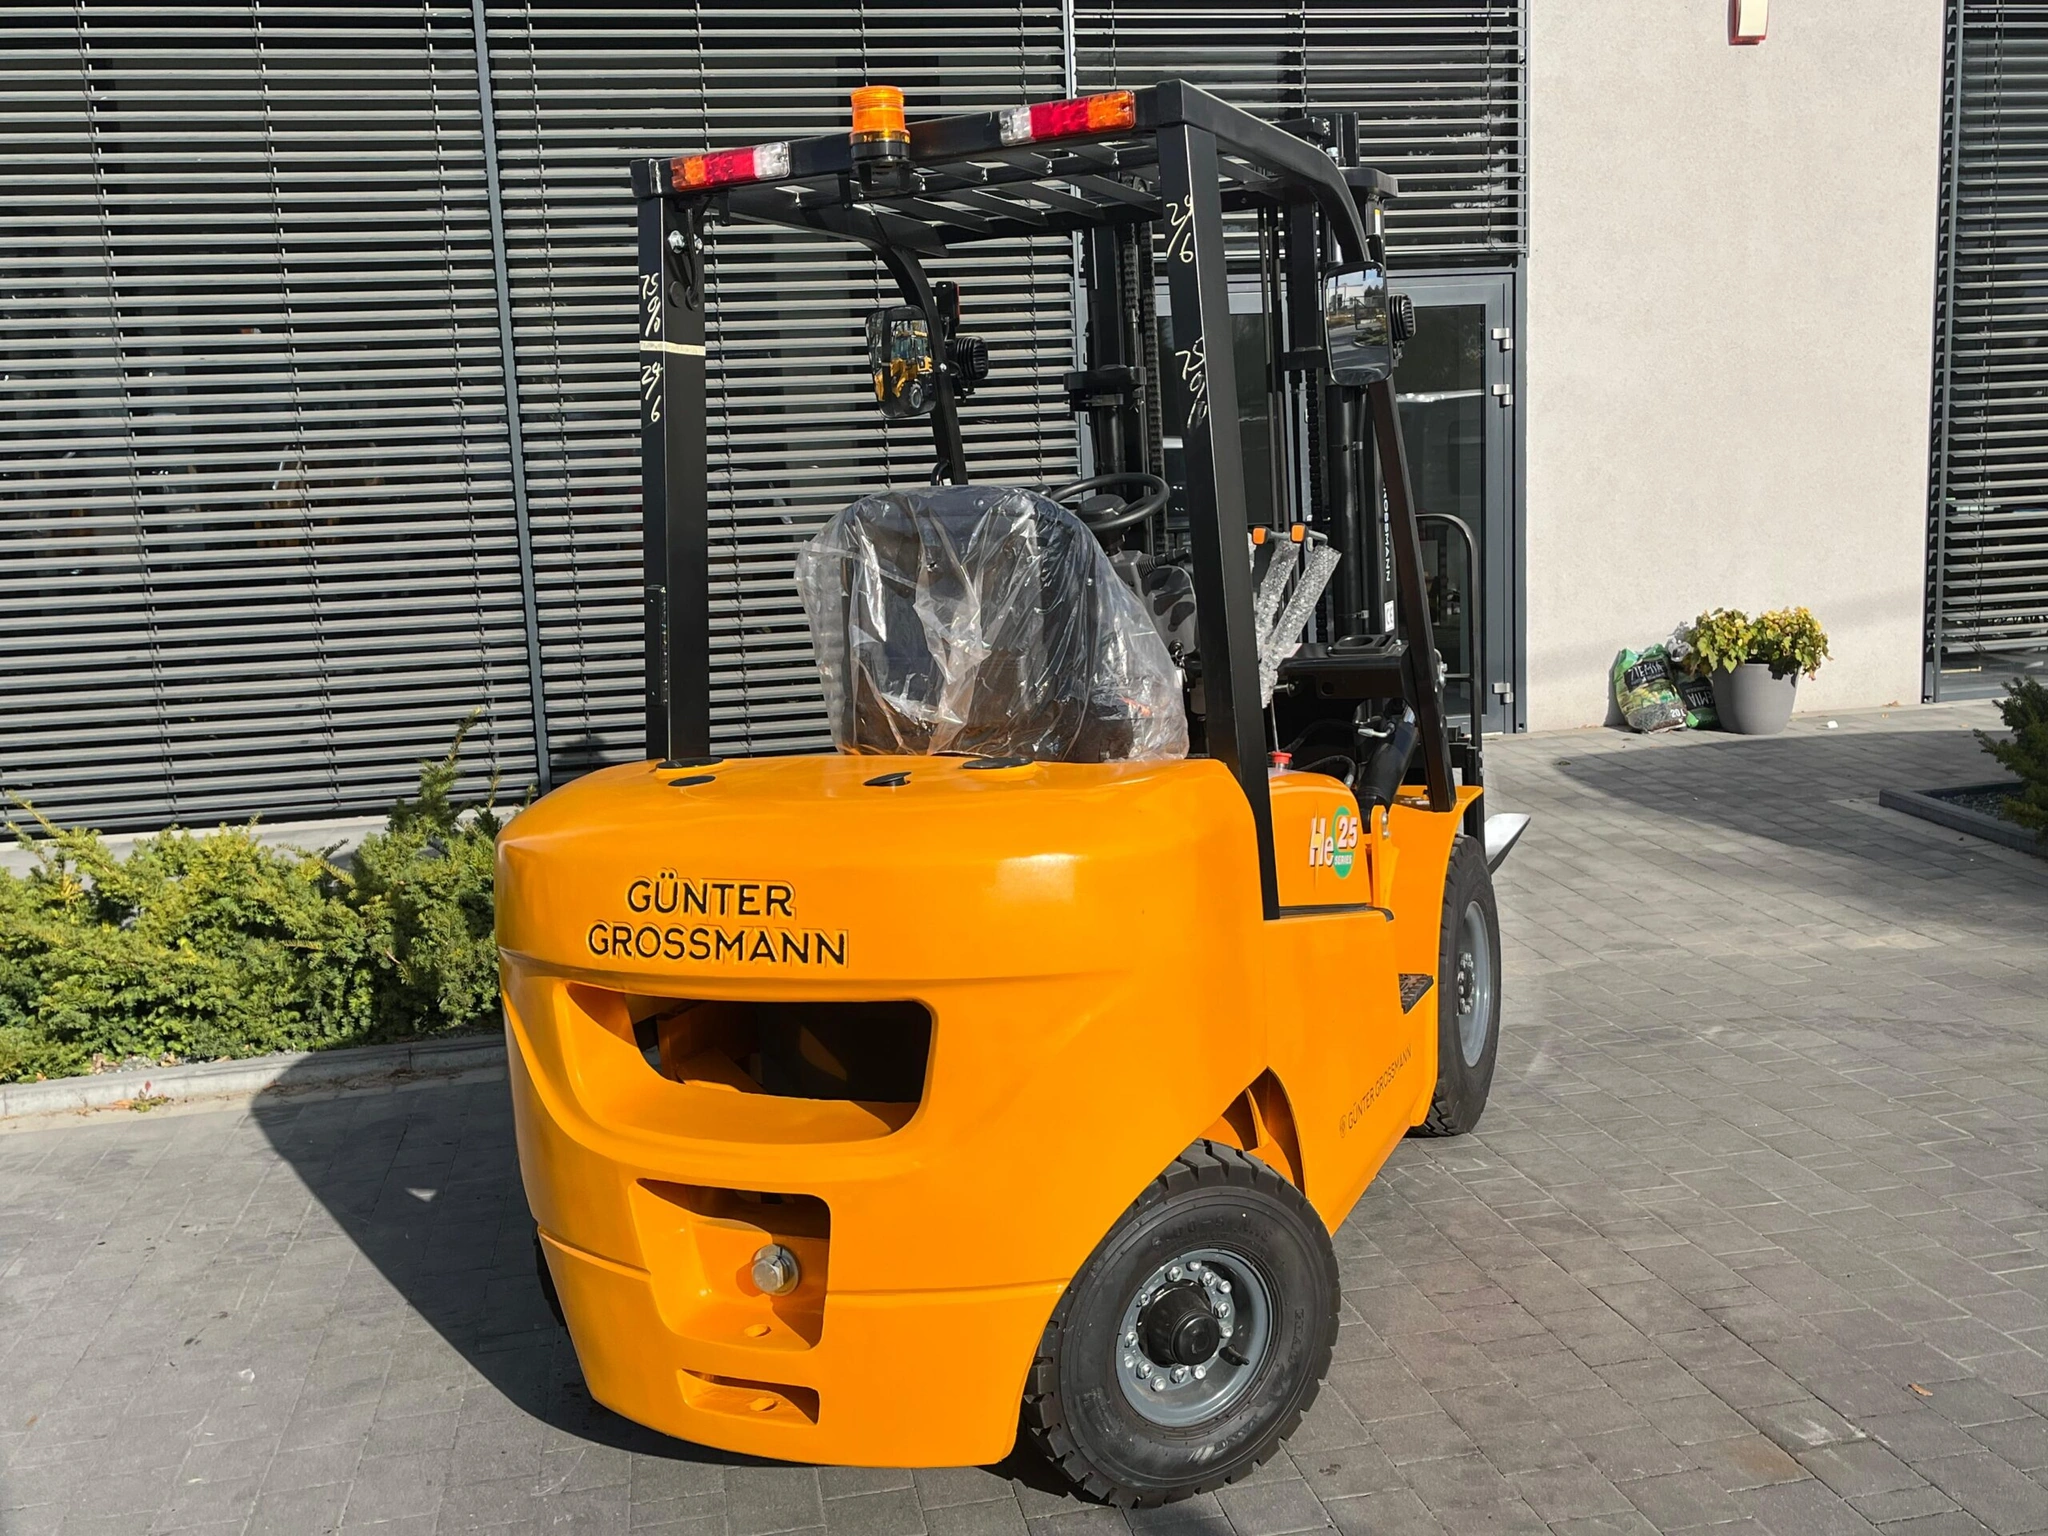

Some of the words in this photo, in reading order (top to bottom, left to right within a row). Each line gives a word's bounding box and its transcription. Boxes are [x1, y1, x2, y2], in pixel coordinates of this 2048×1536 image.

[1336, 814, 1359, 850] 25
[626, 868, 795, 918] GÜNTER
[586, 921, 847, 967] GROSSMANN
